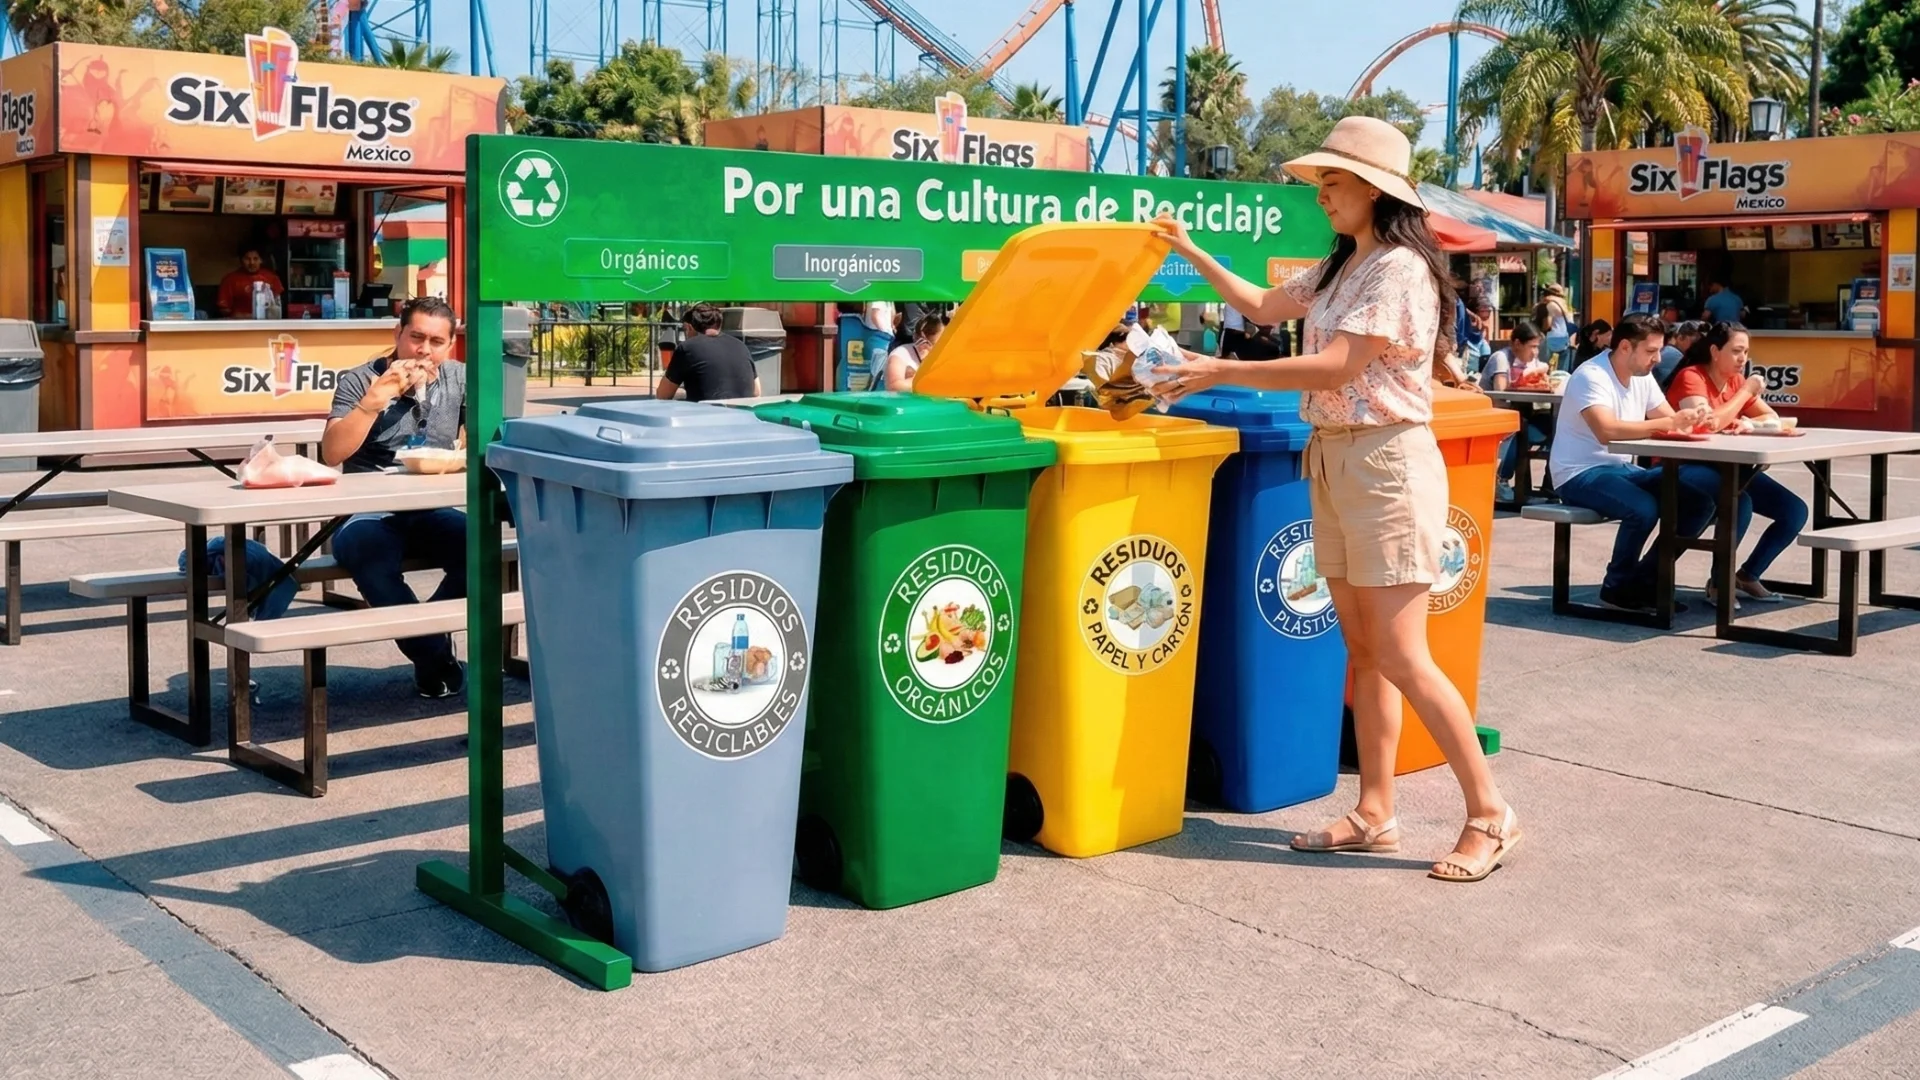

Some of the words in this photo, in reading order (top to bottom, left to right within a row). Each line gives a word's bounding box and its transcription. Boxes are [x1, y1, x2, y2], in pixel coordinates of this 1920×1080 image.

[2, 91, 34, 136] Flags
[168, 76, 251, 124] Six
[290, 85, 412, 141] Flags
[346, 144, 411, 162] Mexico
[892, 129, 939, 161] Six
[1630, 164, 1677, 192] Six
[1702, 160, 1785, 194] Flags
[724, 166, 804, 215] Por
[821, 184, 901, 219] una
[916, 178, 1062, 224] Cultura
[1075, 186, 1120, 222] de
[1133, 189, 1283, 242] Reciclaje
[600, 248, 699, 274] Orgánicos
[805, 252, 901, 277] Inorgánicos
[223, 366, 271, 393] Six
[296, 364, 349, 391] Fla
[1744, 360, 1799, 391] lags
[897, 551, 1003, 604] RESIDUOS
[1090, 539, 1186, 587] RESIDUOS
[676, 578, 799, 632] RESIDUOS
[1088, 621, 1130, 669] PAPEL
[1137, 653, 1147, 669] Y
[1152, 602, 1192, 664] CARTÓN
[895, 652, 1004, 717] ORGÁNICOS
[668, 689, 797, 753] RECICLABLES
